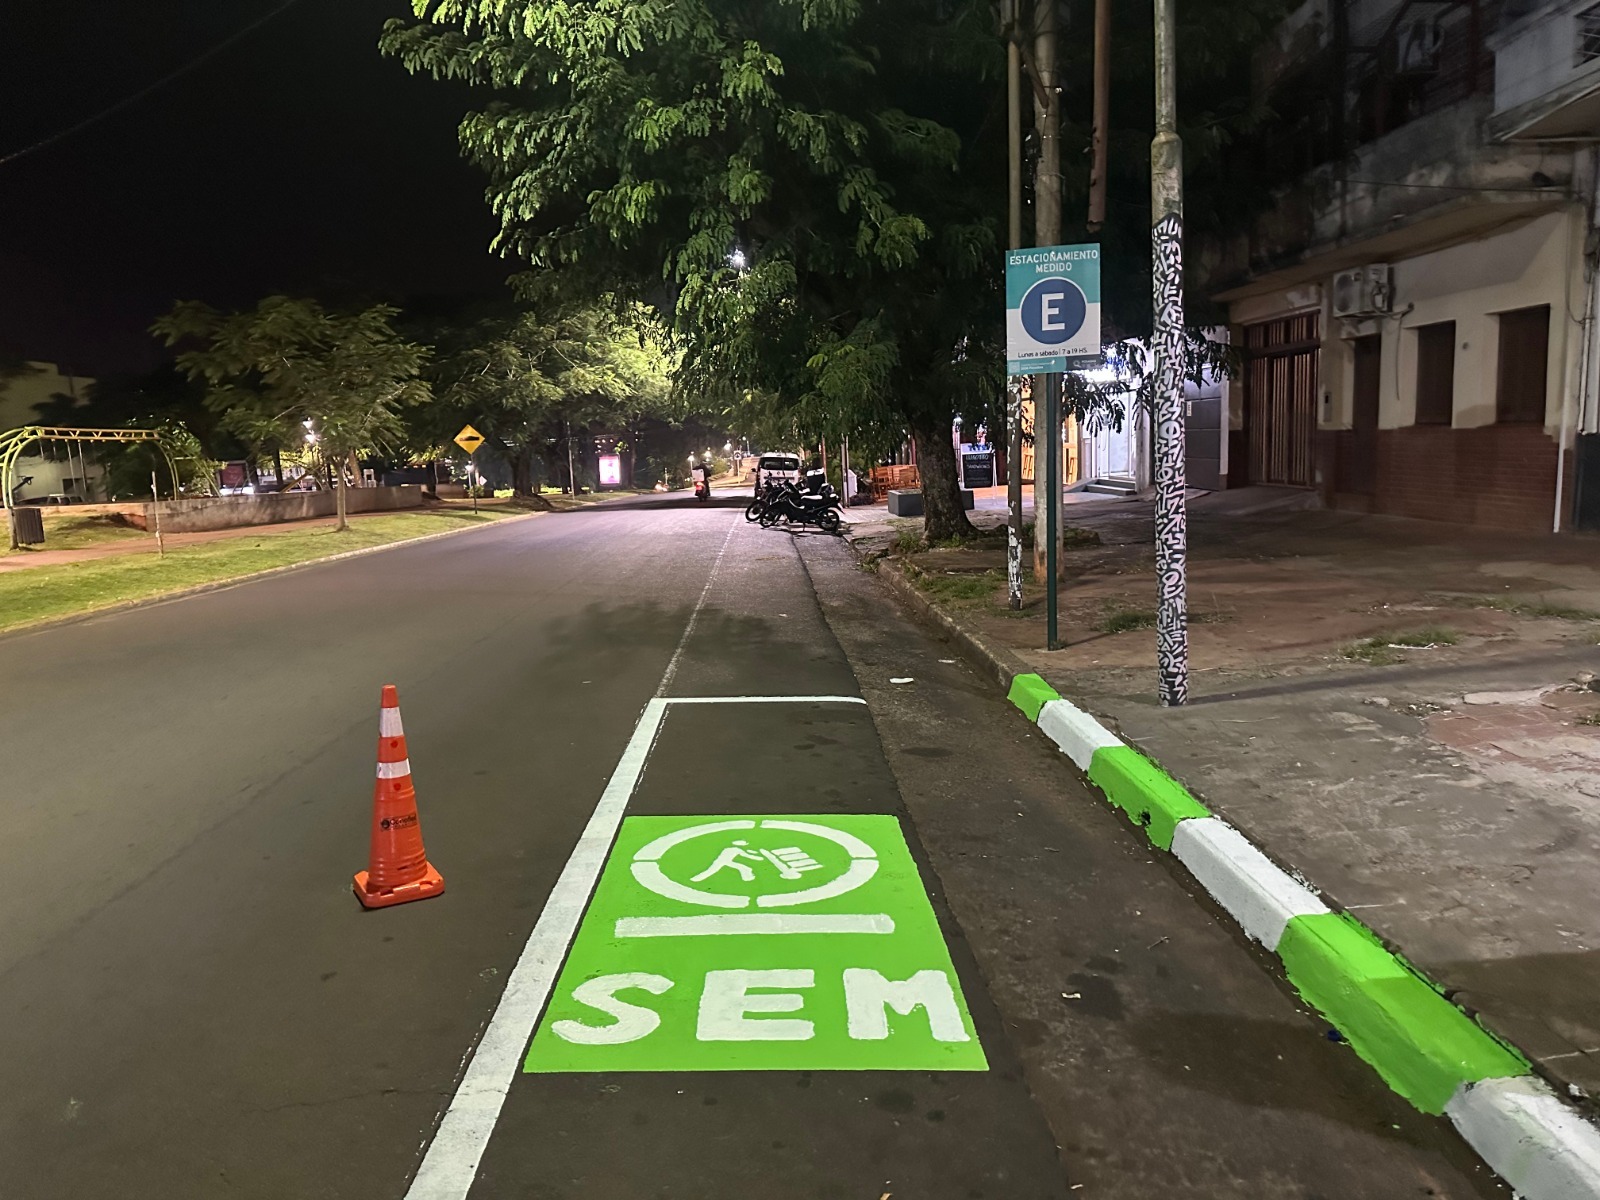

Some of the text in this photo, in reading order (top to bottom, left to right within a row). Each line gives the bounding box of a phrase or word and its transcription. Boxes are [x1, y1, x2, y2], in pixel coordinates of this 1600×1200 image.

[1009, 249, 1098, 265] ESTACIONAMIENTO
[1035, 262, 1073, 273] MEDIDO
[1041, 292, 1066, 331] E
[551, 968, 971, 1045] SEM
